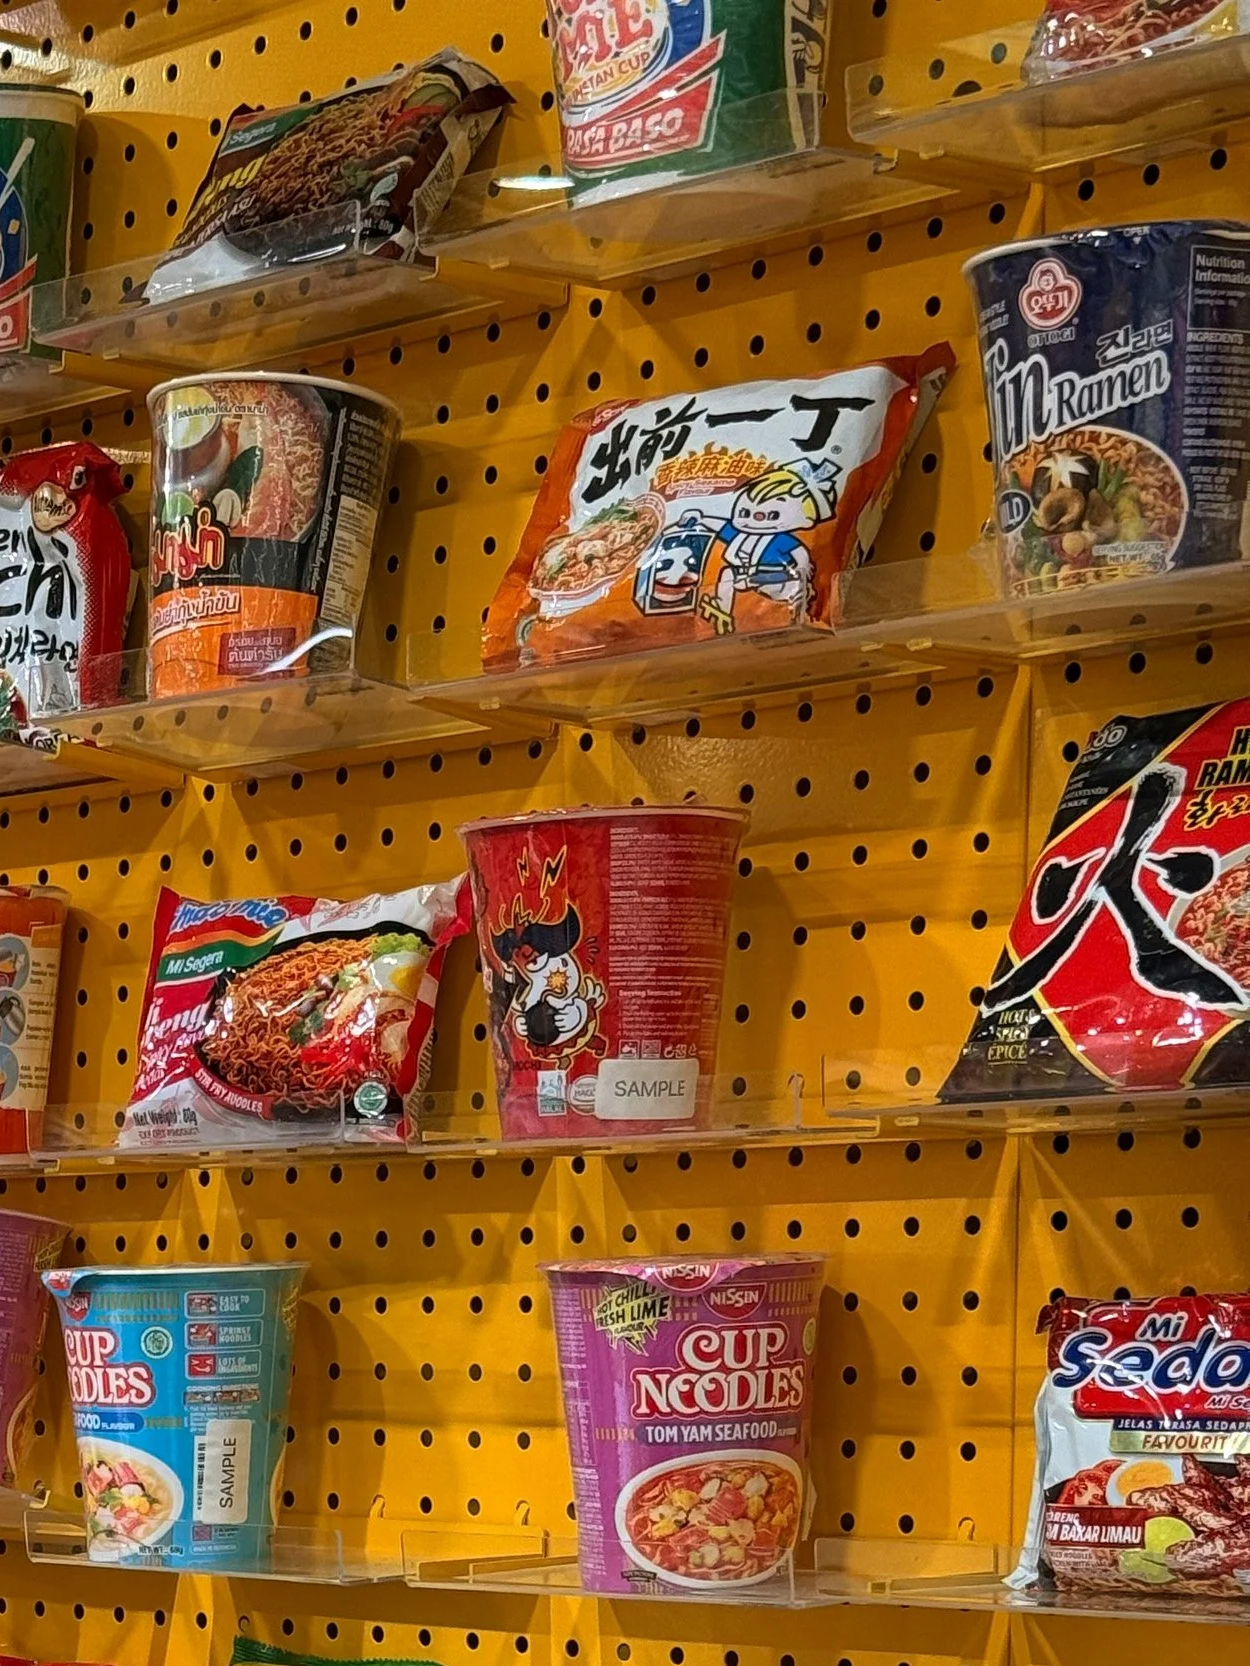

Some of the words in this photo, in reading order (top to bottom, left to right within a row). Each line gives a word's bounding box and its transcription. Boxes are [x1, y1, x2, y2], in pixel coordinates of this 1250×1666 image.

[618, 52, 651, 75] CUP
[567, 123, 606, 154] RASA
[610, 108, 684, 153] BASO
[1196, 253, 1246, 270] Nutrition
[1027, 328, 1076, 348] OTTOGI
[1096, 320, 1174, 366] 진라면
[1186, 332, 1244, 345] INGREDIENTS
[1055, 353, 1169, 427] Ramen
[581, 394, 876, 503] 出前一丁
[655, 453, 770, 487] 香辣麻油味
[166, 960, 184, 975] Mi
[185, 950, 224, 973] Segera
[195, 1068, 212, 1089] STIR
[209, 1080, 225, 1099] FRY
[614, 1080, 686, 1098] SAMPLE
[240, 1295, 249, 1304] TO
[630, 1298, 670, 1320] LIME
[710, 1288, 761, 1307] NISSIN
[1139, 1314, 1186, 1340] Mi
[65, 1330, 116, 1367] CUP
[682, 1326, 785, 1371] CUP
[633, 1362, 805, 1414] NOODLES
[645, 1424, 678, 1444] TOM
[680, 1424, 712, 1443] YAM
[714, 1422, 778, 1442] SEAFOOD
[1118, 1420, 1152, 1429] JELAS
[219, 1438, 237, 1509] SAMPLE
[1060, 1524, 1099, 1542] BAKAR
[1101, 1526, 1142, 1544] LIMAU
